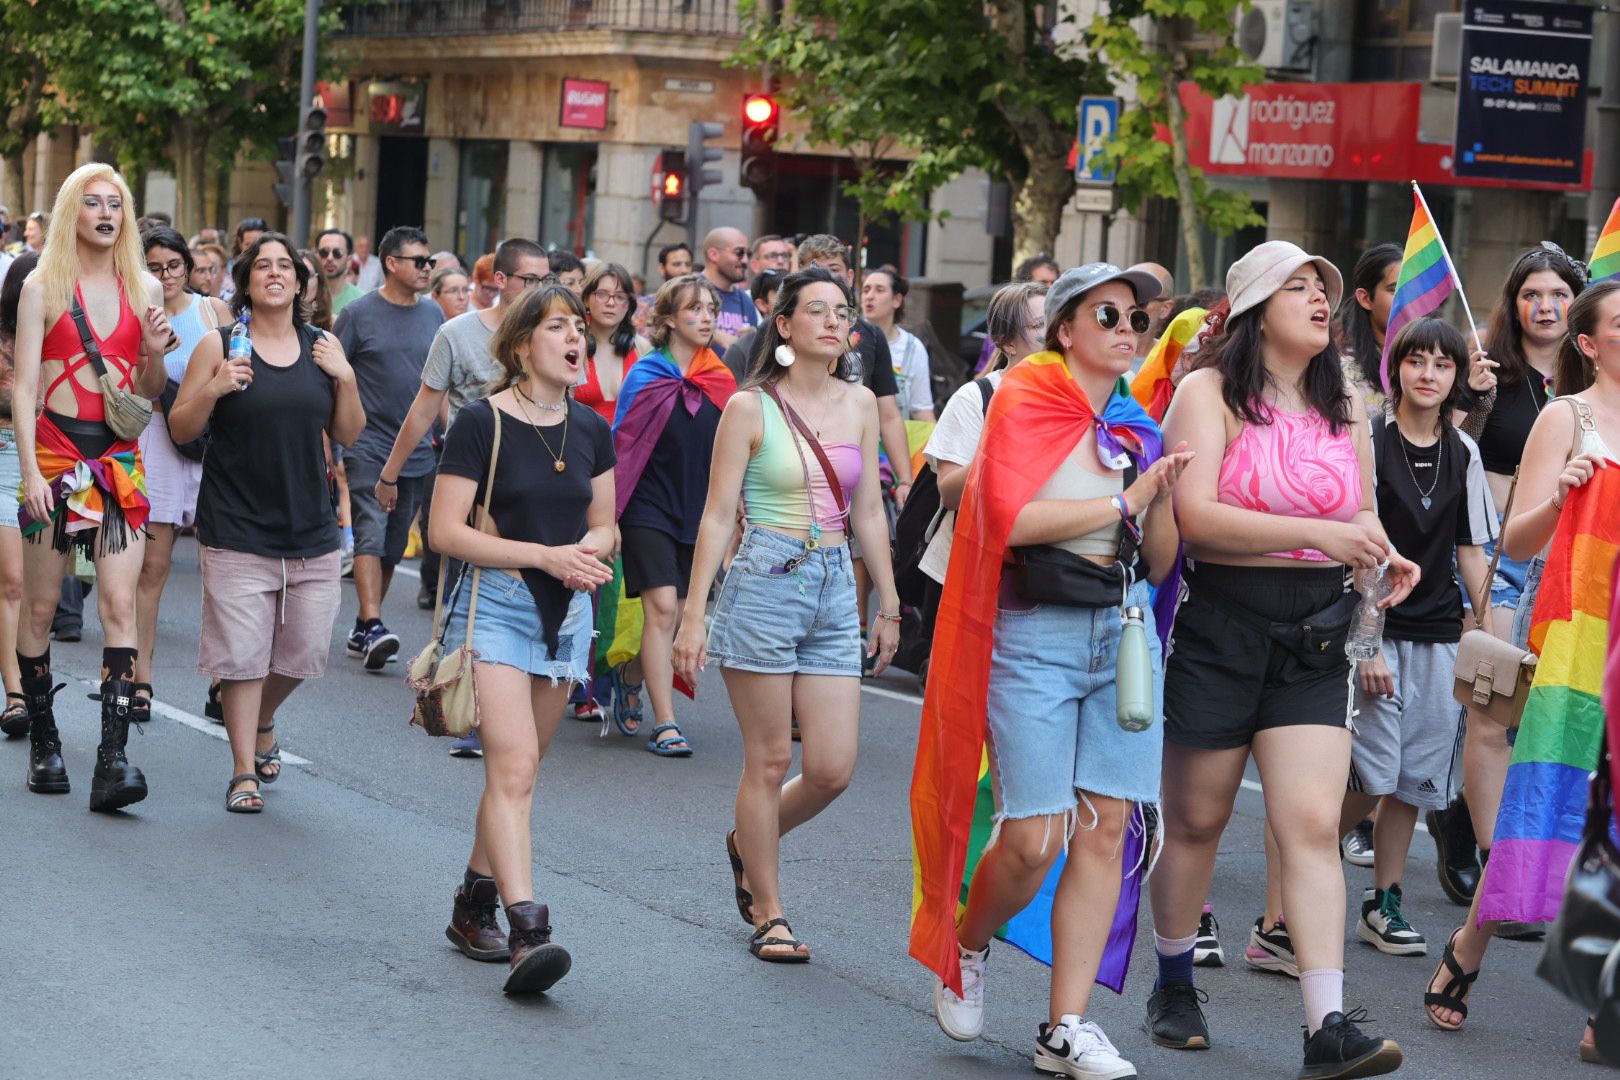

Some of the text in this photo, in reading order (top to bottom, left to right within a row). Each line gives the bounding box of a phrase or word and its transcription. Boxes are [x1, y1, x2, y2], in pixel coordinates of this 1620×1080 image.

[1470, 56, 1580, 80] SALAMANCA
[1470, 75, 1580, 97] TECH SUMMIT
[1251, 94, 1335, 129] rodríguez
[1079, 105, 1112, 178] P
[1248, 142, 1334, 167] manzano
